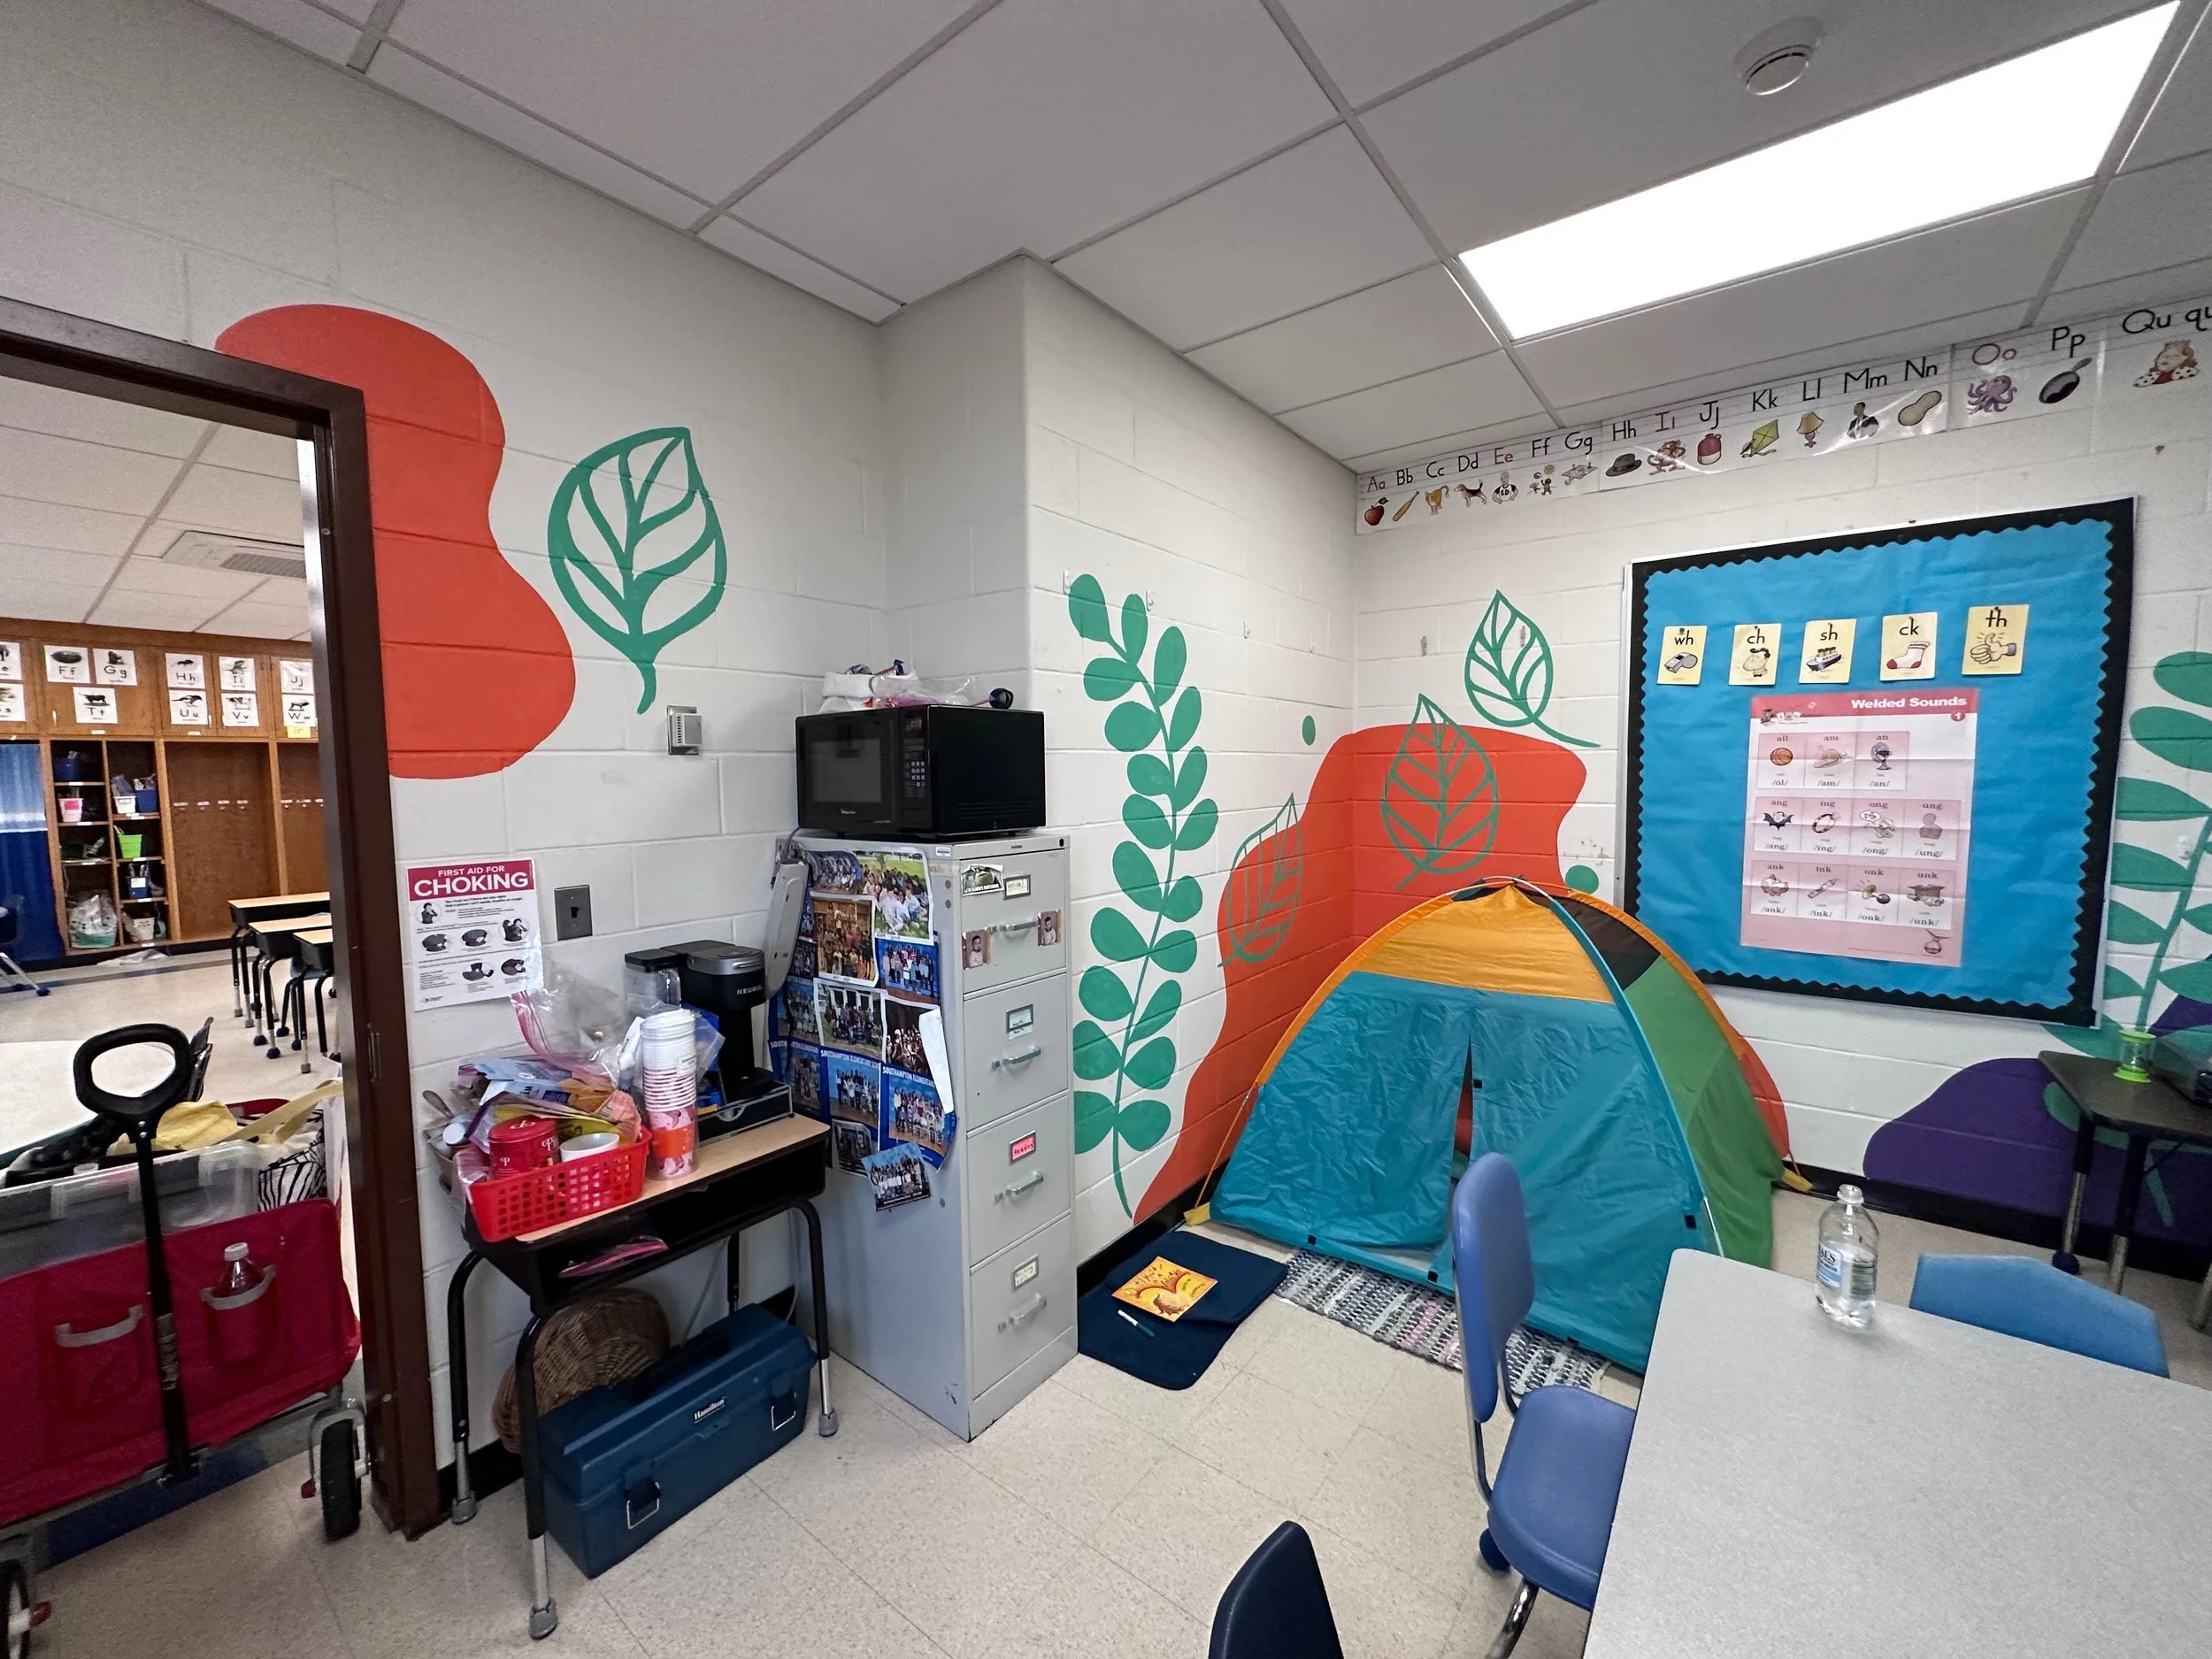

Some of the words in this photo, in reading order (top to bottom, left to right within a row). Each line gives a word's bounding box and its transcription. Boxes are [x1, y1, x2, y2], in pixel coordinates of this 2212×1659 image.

[1367, 476, 1386, 493] Aa
[1396, 468, 1414, 486] Bb
[1426, 461, 1445, 478] Cc
[1457, 452, 1479, 472] Dd
[1494, 447, 1514, 465] Ee
[1532, 437, 1551, 457] Ff
[1564, 431, 1593, 456] Gg
[1612, 419, 1637, 442] Hh
[1655, 411, 1676, 433] Ii
[1699, 400, 1719, 430] Jj
[1752, 388, 1778, 411] Kk
[1802, 379, 1821, 402] Ll
[1844, 368, 1887, 394] Mm
[1904, 356, 1938, 381] Nn
[1971, 342, 2017, 366] Oo
[2052, 326, 2085, 358] Pp
[2122, 309, 2171, 334] Qu
[1985, 608, 2008, 628] th
[1820, 624, 1838, 641] sh
[1899, 618, 1920, 636] ck
[1674, 629, 1694, 646] wh
[1747, 628, 1765, 645] ch
[1851, 698, 1906, 709] Welded
[1909, 696, 1968, 708] Sounds
[438, 868, 465, 878] FIRST
[466, 866, 484, 875] AID
[414, 872, 528, 897] CHOKING
[736, 984, 763, 995] KEURIG
